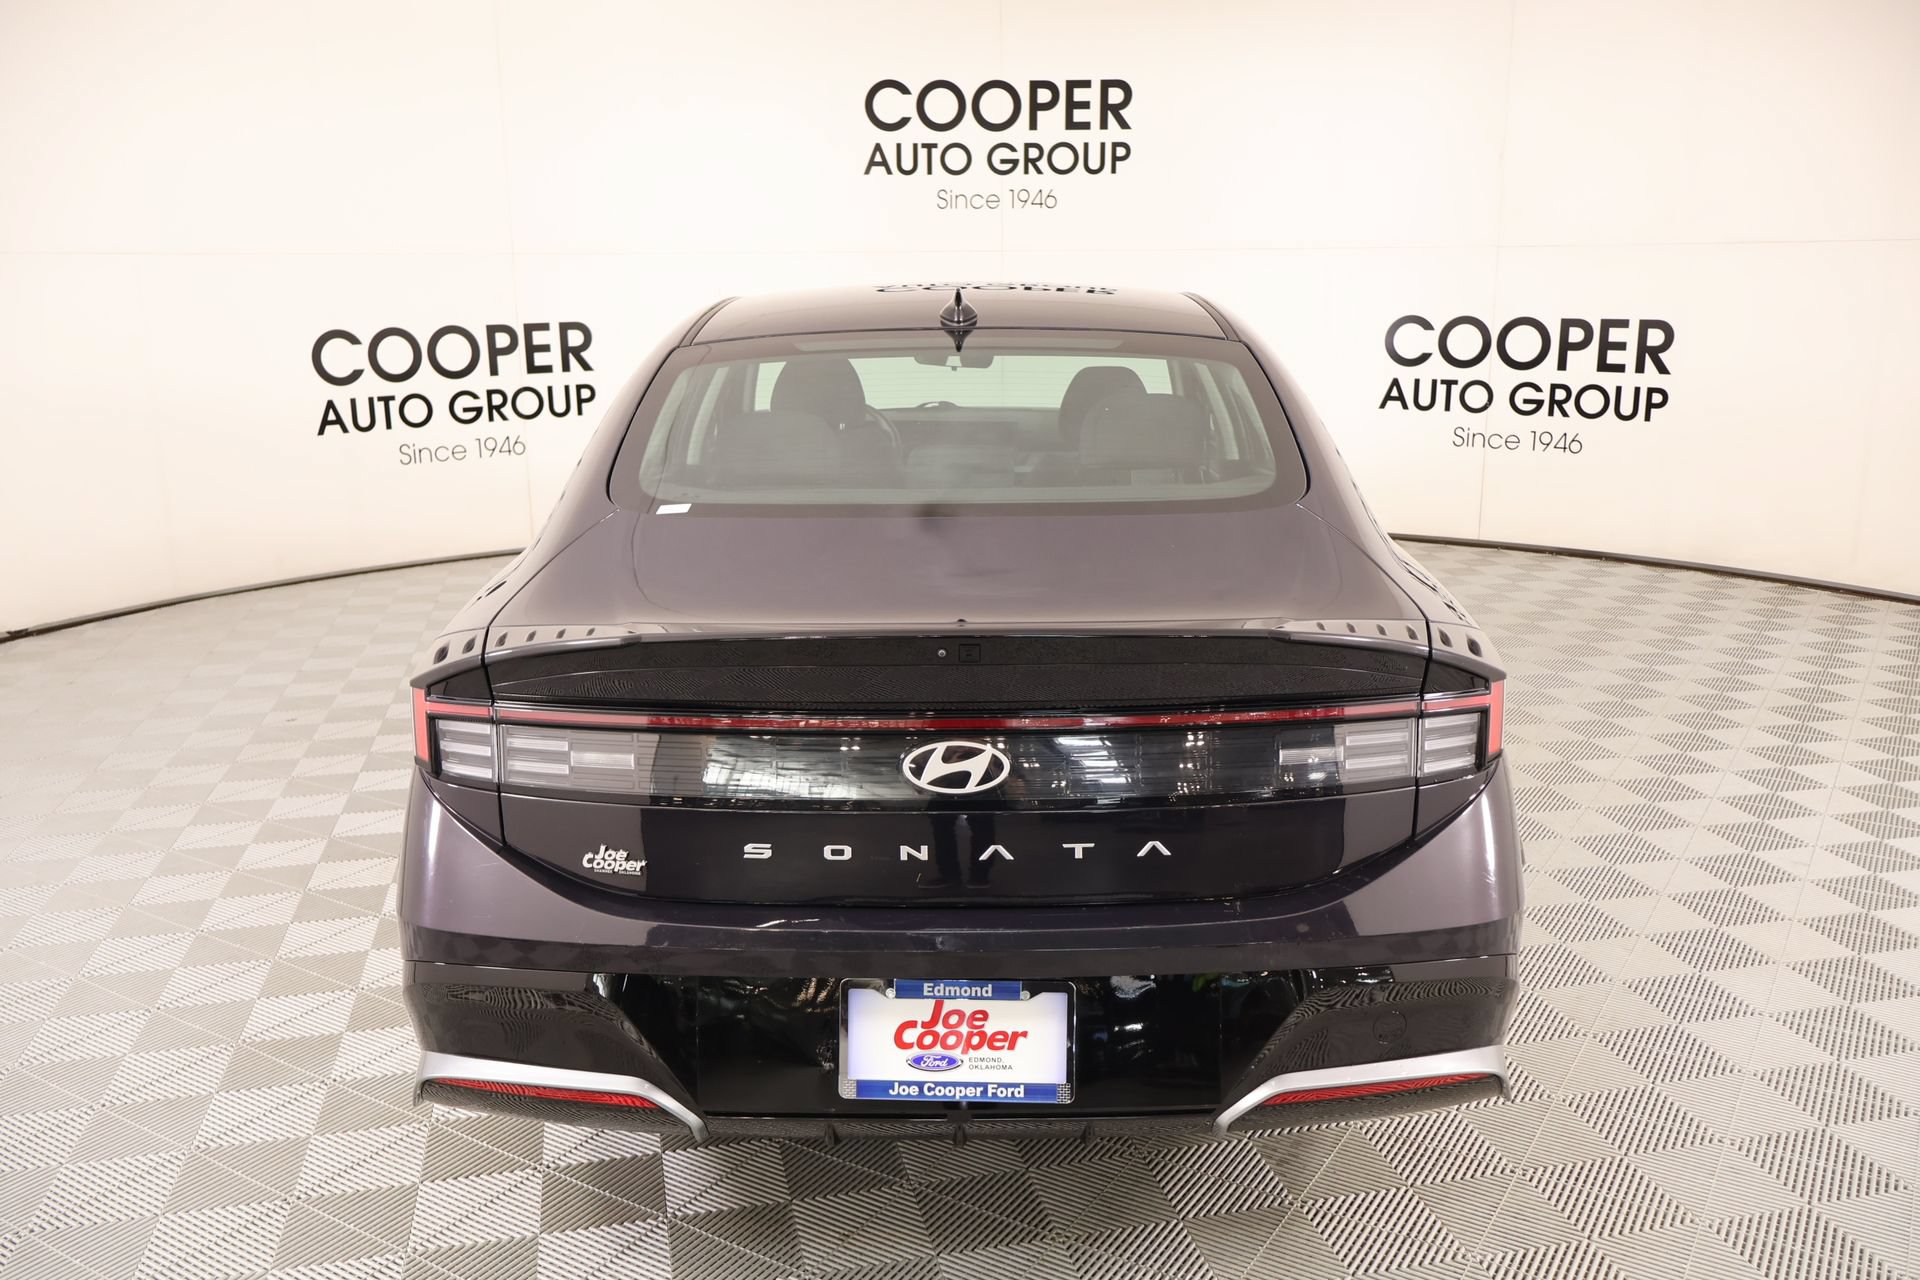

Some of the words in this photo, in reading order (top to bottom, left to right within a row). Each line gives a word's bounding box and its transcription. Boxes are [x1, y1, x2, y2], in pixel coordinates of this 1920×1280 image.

[865, 79, 1132, 132] COOPER
[864, 142, 972, 175] AUTO
[987, 142, 1131, 175] GROUP
[937, 189, 1000, 209] Since
[1009, 189, 1057, 209] 1946
[312, 322, 594, 386] COOPER
[1385, 315, 1674, 375] COOPER
[318, 393, 433, 436] AUTO
[449, 384, 596, 424] GROUP
[1379, 378, 1493, 413] AUTO
[1509, 382, 1668, 422] GROUP
[399, 443, 466, 465] Since
[475, 435, 526, 458] 1946
[1453, 427, 1520, 450] Since
[1531, 431, 1582, 454] 1946
[582, 852, 647, 872] Cooper
[595, 844, 628, 860] Joe
[743, 841, 1171, 860] SONATA
[923, 983, 992, 997] Edmond
[921, 1000, 989, 1030] Joe
[894, 1020, 1028, 1054] Cooper
[921, 1055, 949, 1068] Ford
[889, 1083, 919, 1096] Joe
[924, 1084, 984, 1099] Cooper
[988, 1084, 1025, 1098] Ford
